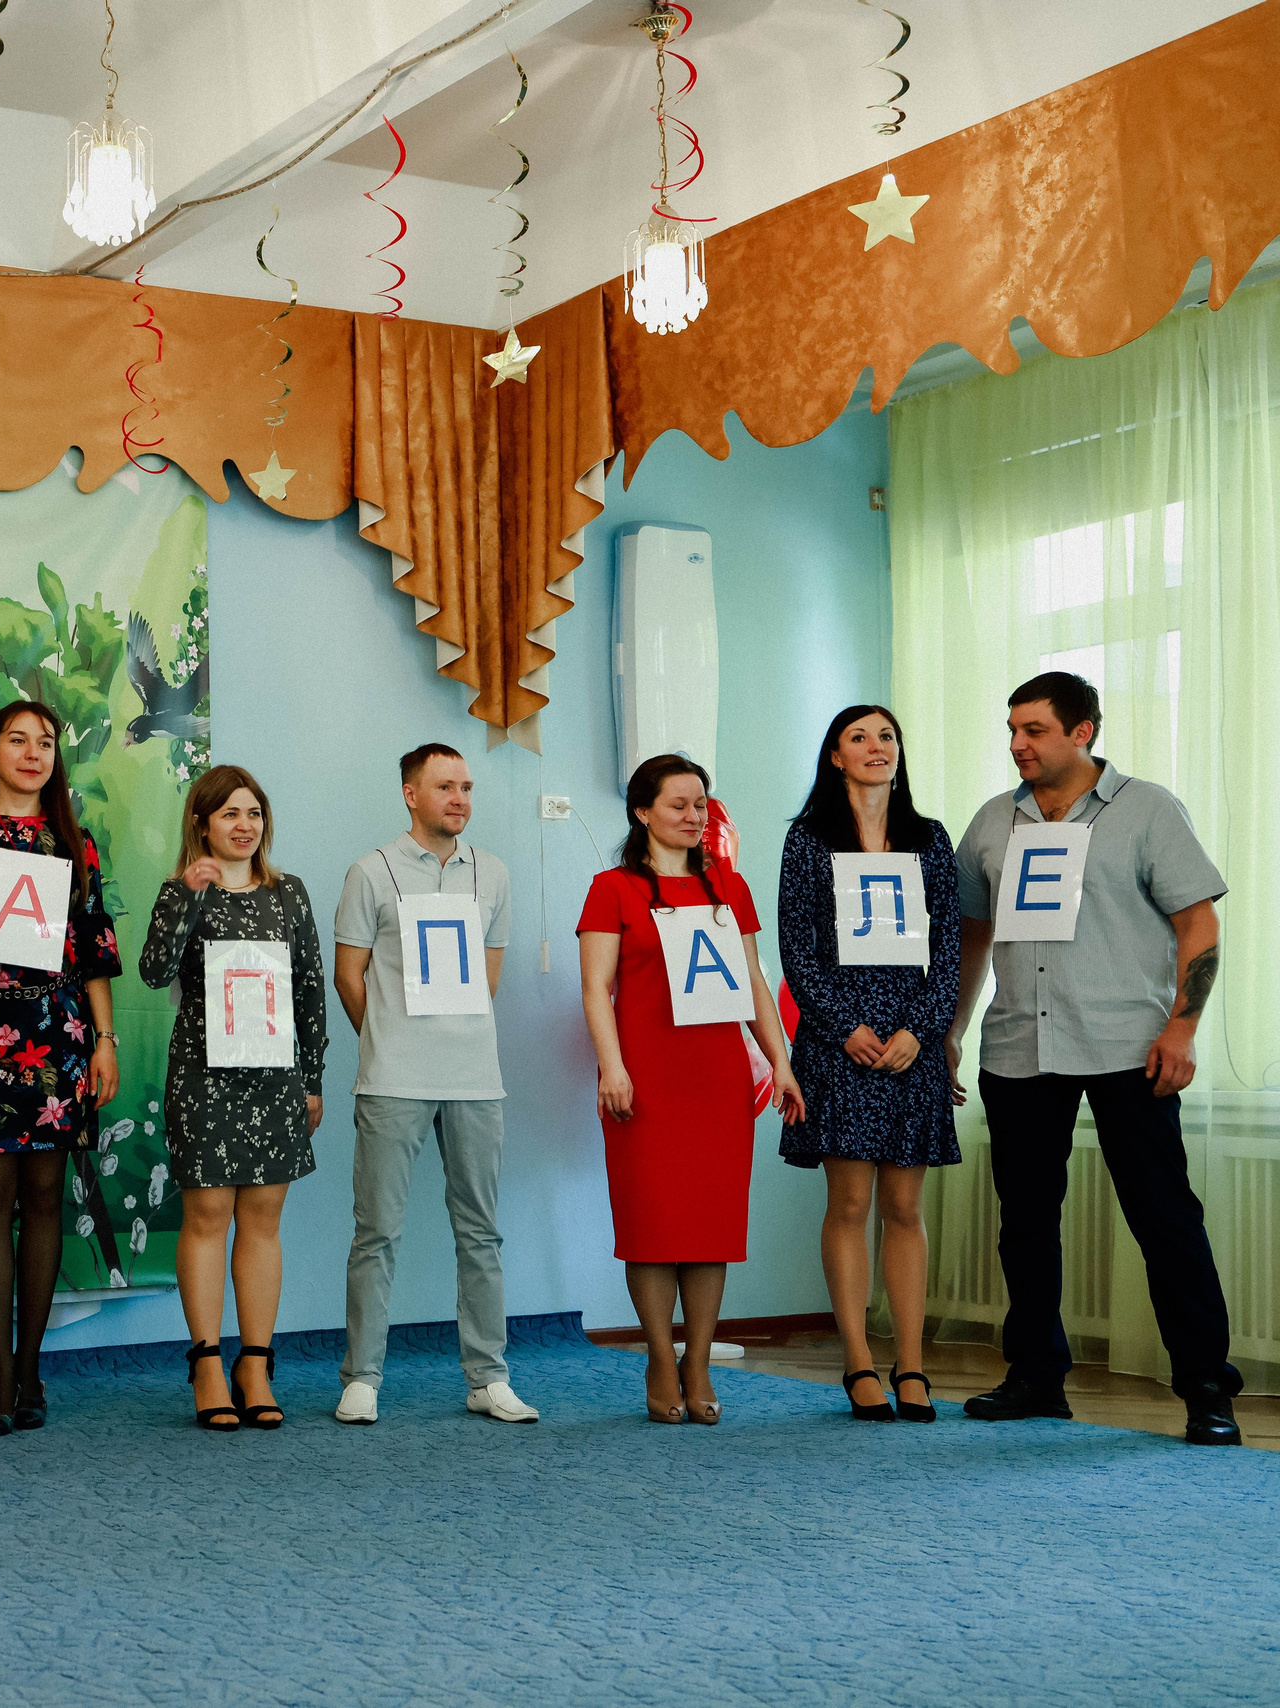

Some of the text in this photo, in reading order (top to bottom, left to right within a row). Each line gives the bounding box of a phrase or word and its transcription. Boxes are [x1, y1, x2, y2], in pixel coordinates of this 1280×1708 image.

[852, 874, 907, 938] Л
[1015, 847, 1068, 911] Е
[416, 919, 470, 985] П
[683, 929, 740, 994] А
[223, 969, 277, 1036] П
